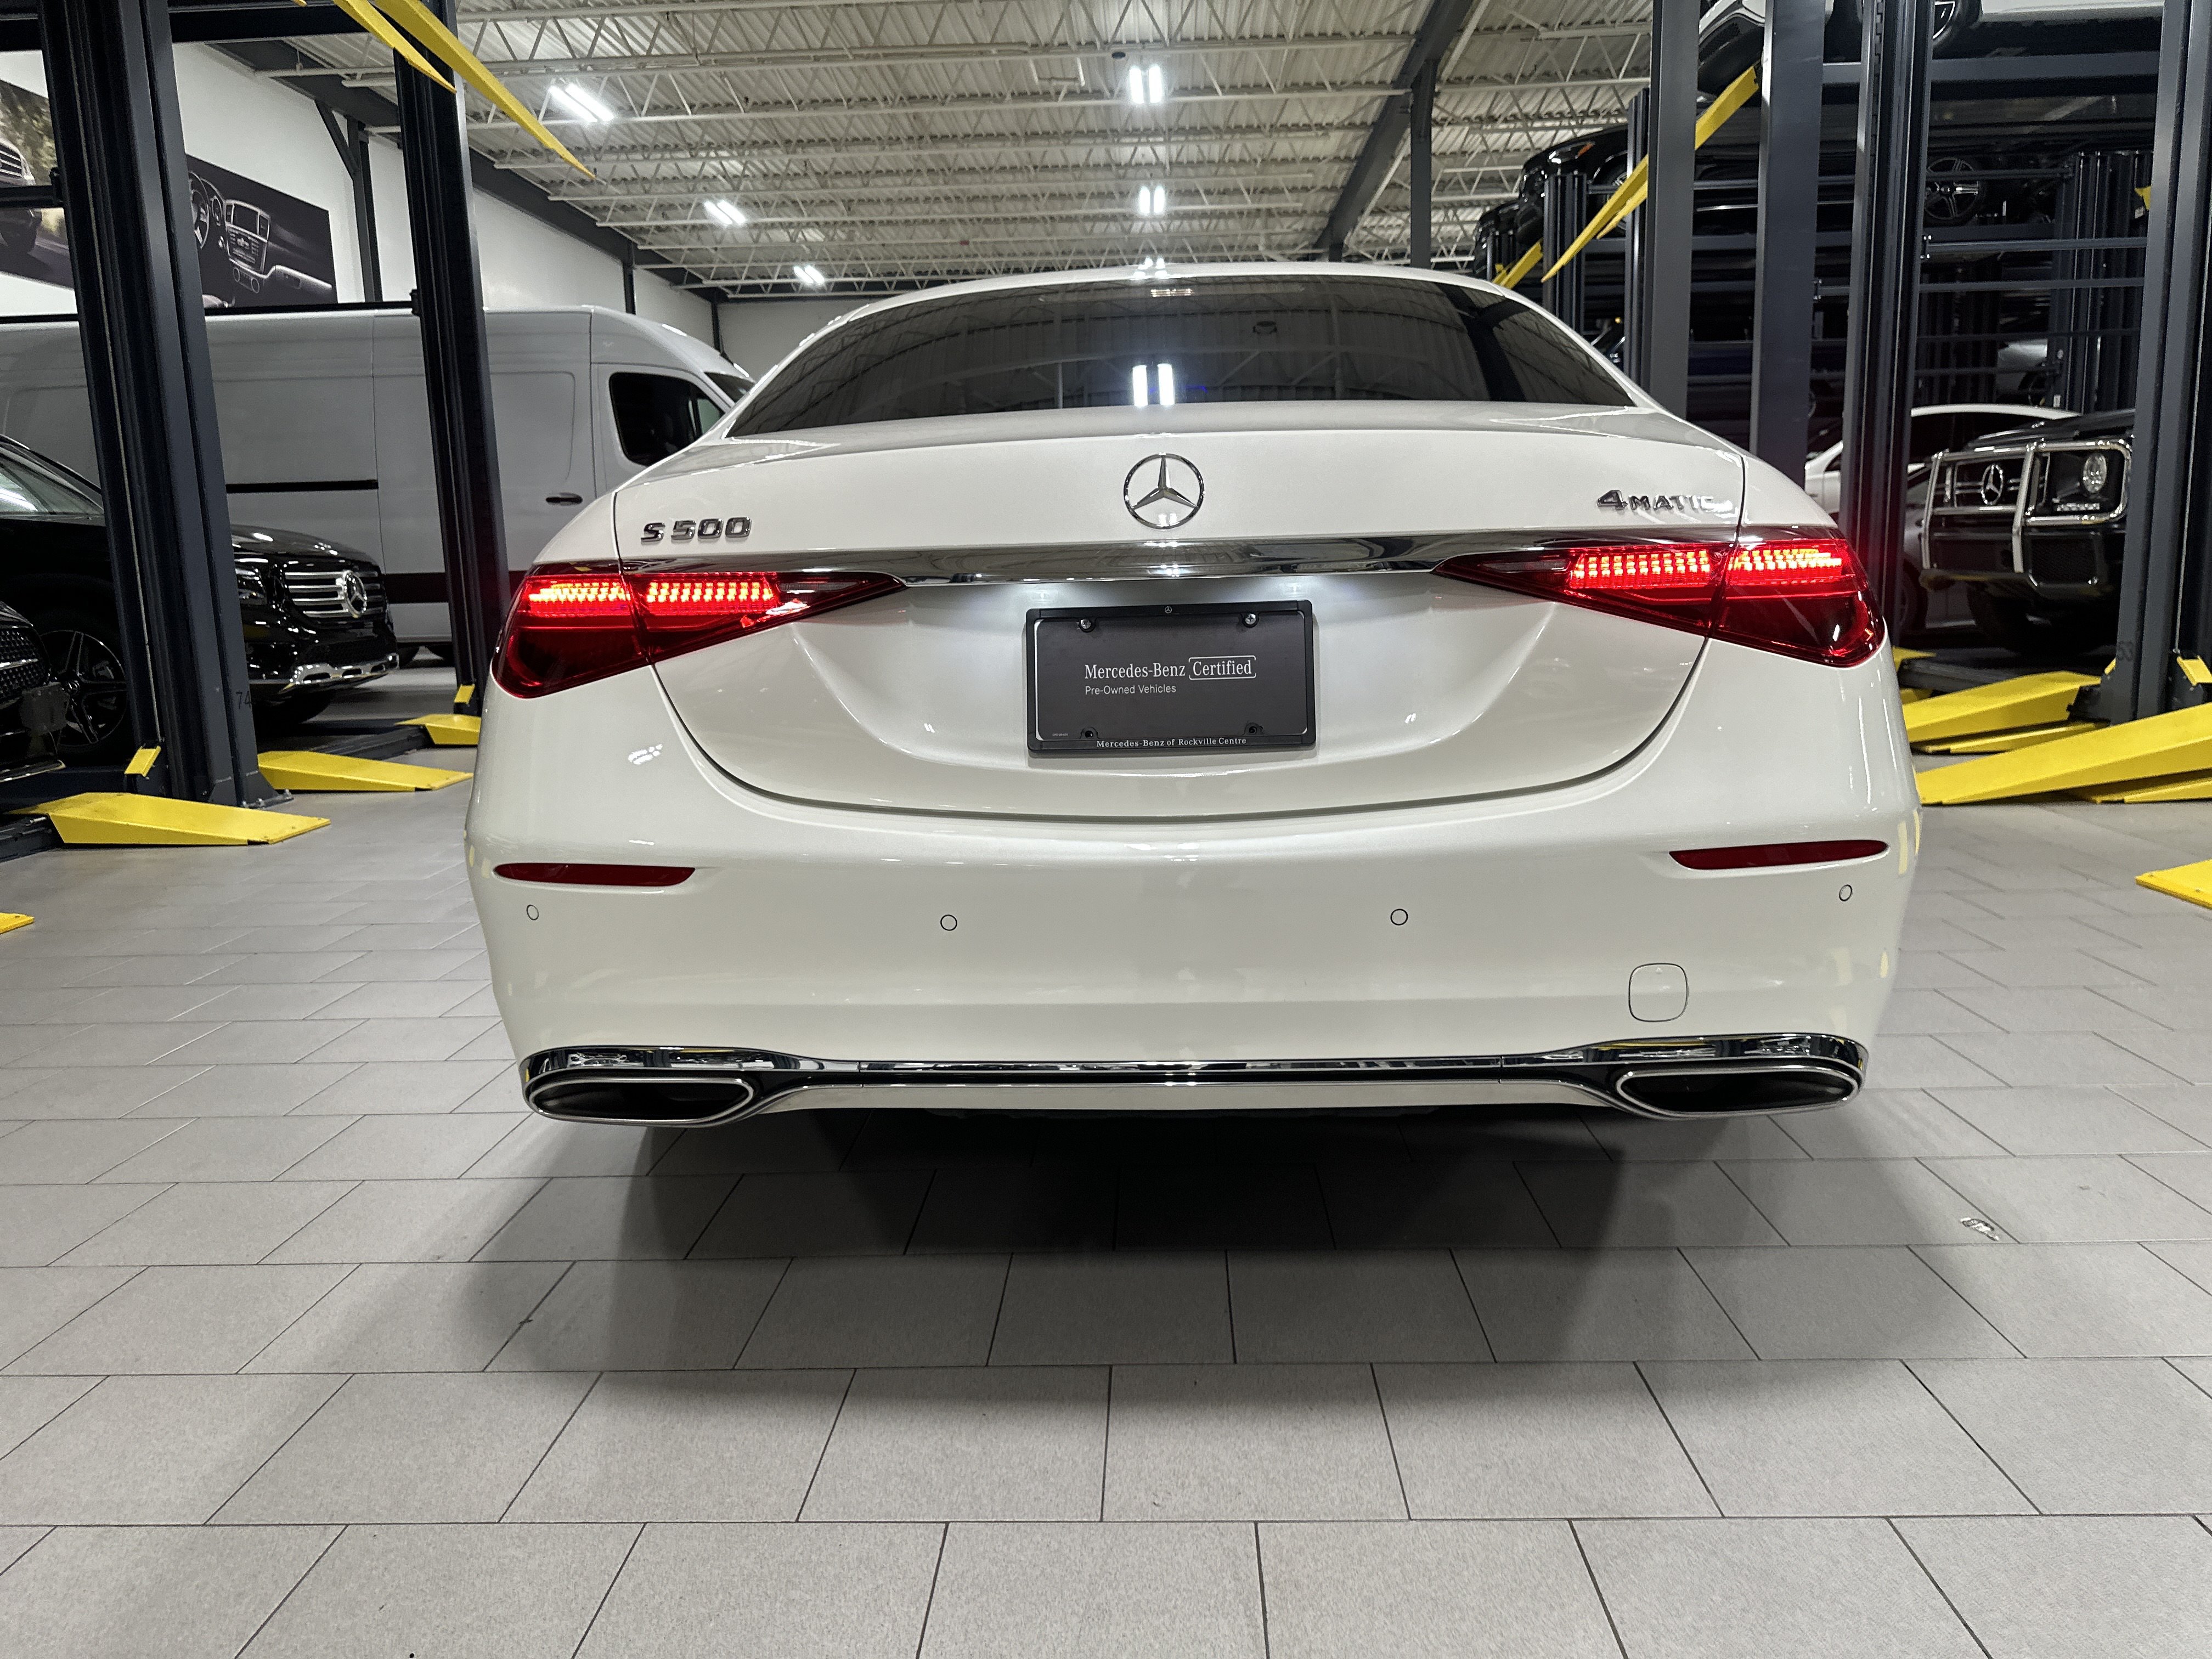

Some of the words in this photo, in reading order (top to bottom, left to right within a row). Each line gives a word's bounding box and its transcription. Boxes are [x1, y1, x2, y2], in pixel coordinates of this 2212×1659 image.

[1597, 489, 1716, 510] 4MATIC
[641, 522, 665, 542] S
[671, 517, 752, 540] 500
[1085, 662, 1186, 679] Mercedes-Benz
[1193, 660, 1252, 676] Certified
[1085, 685, 1135, 695] Pre-Owned
[1137, 684, 1176, 694] Vehicles
[235, 691, 251, 709] 74
[1097, 740, 1165, 748] Mercedes-Benz
[1178, 738, 1217, 746] Rockville
